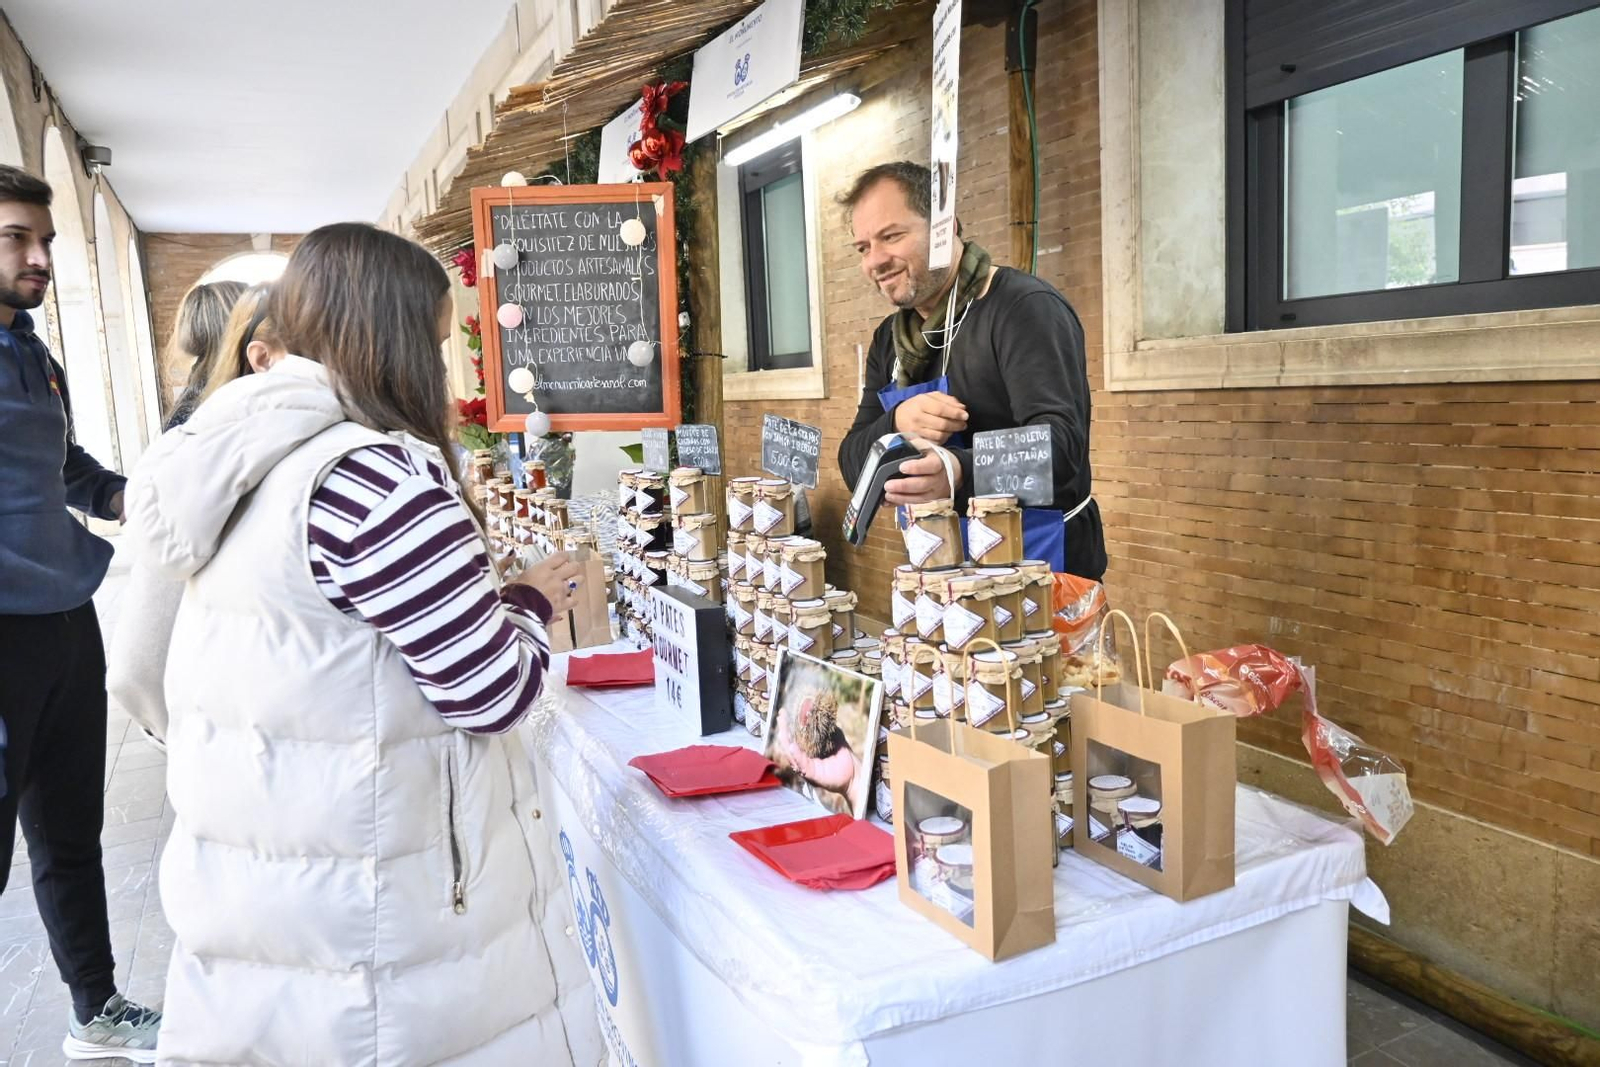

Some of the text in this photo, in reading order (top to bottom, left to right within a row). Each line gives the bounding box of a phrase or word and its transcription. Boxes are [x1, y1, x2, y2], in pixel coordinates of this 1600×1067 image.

[574, 211, 600, 229] CON
[607, 211, 623, 229] LA
[579, 234, 596, 251] DE
[537, 305, 560, 326] LOS
[563, 304, 627, 327] MEJORES
[505, 324, 646, 344] INGREDIENTES PARA
[507, 348, 534, 366] UNA
[538, 346, 613, 364] EXPERIENCIA
[995, 435, 1006, 449] DE
[1014, 430, 1049, 445] BOLETUS
[975, 454, 994, 466] CON
[995, 474, 1035, 494] 5,00 €
[652, 596, 685, 638] 3 PATES
[653, 632, 689, 677] GOURMET
